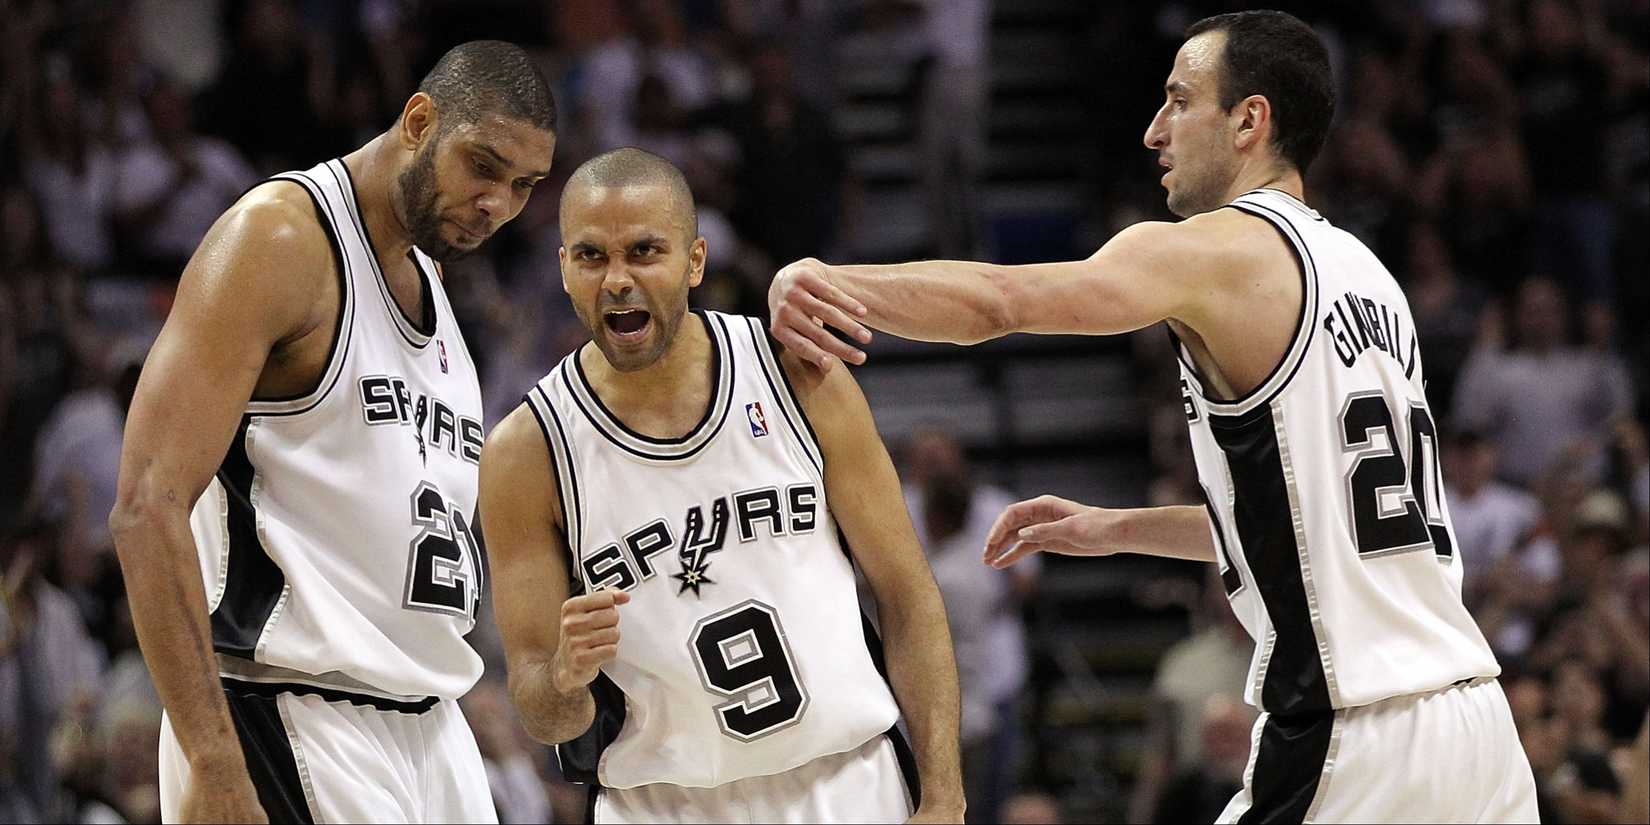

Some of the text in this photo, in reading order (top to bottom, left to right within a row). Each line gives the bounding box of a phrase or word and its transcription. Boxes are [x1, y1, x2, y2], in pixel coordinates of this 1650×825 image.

[582, 483, 818, 600] SPURS
[1337, 389, 1453, 567] 20
[402, 480, 483, 625] 21
[687, 598, 811, 743] 9
